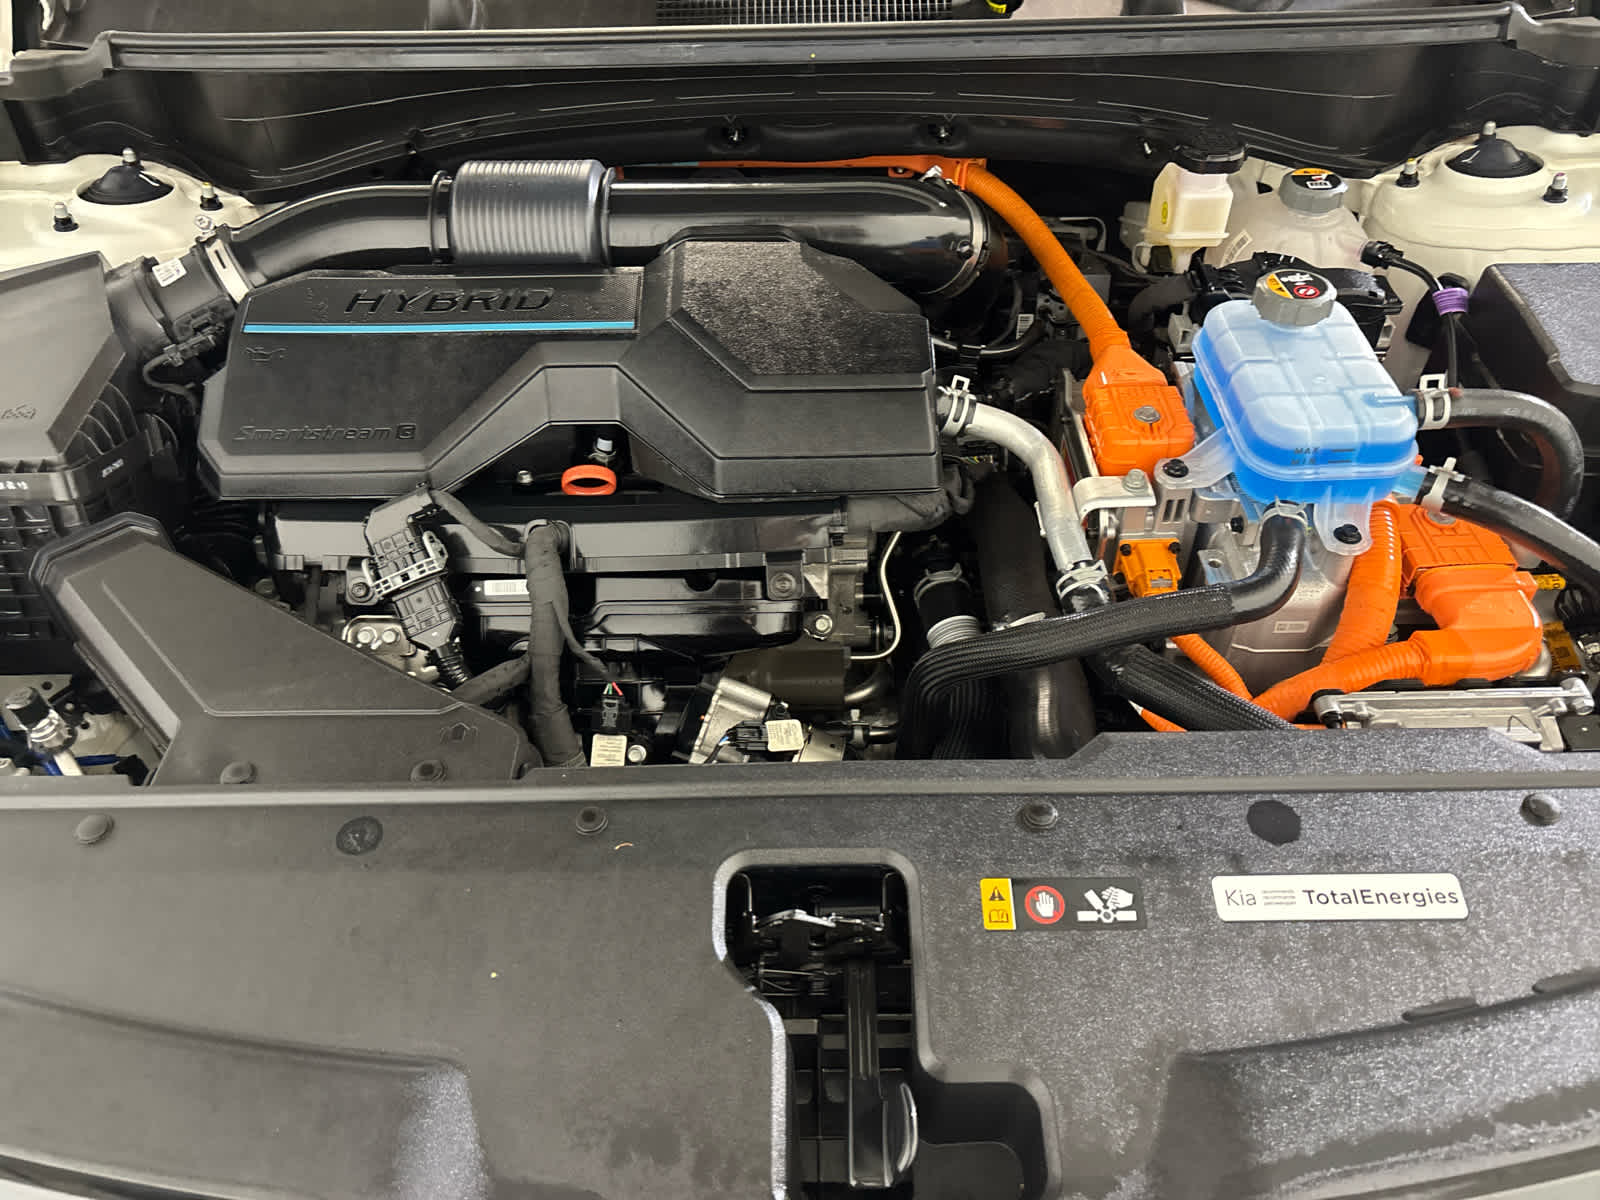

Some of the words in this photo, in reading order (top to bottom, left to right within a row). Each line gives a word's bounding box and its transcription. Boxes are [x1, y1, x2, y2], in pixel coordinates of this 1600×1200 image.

[343, 287, 553, 314] HYBRID
[232, 425, 392, 440] Smartstream
[1224, 888, 1257, 906] Kia
[1302, 887, 1458, 907] TotalEnergies
